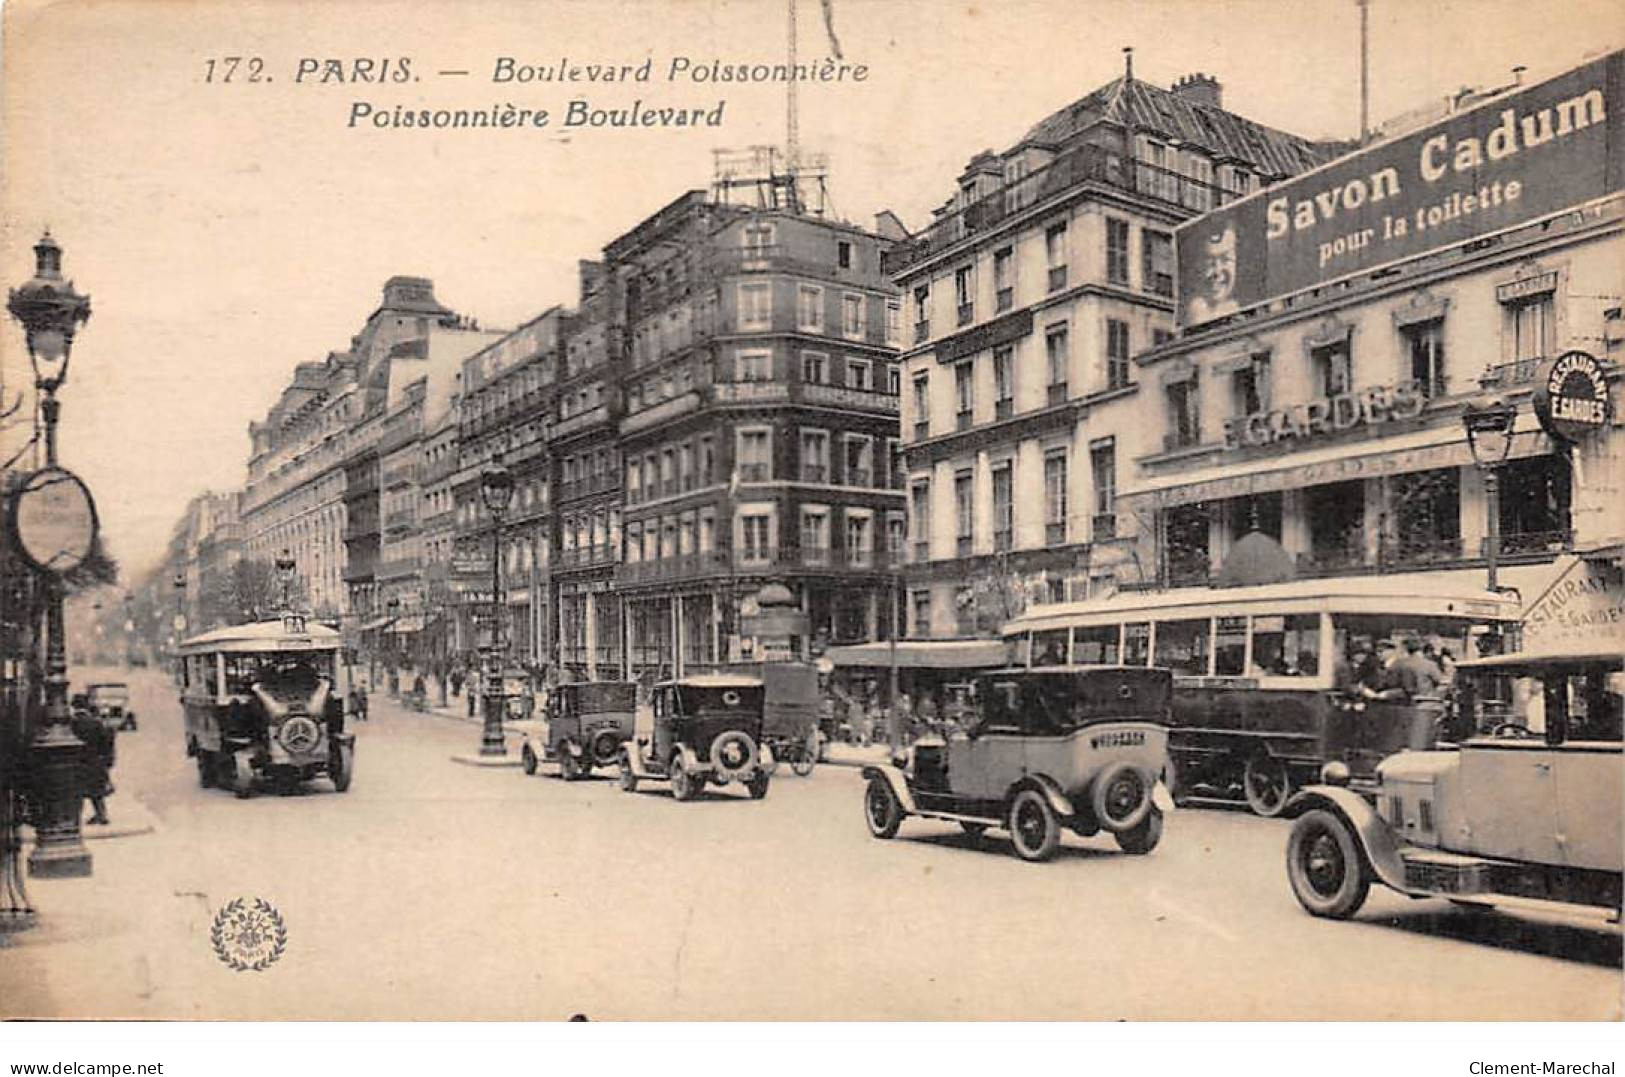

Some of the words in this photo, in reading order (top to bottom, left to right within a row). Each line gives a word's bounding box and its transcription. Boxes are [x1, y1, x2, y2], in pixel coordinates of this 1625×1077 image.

[1267, 166, 1401, 240] Savon
[1420, 89, 1606, 182] Cadum
[1319, 226, 1374, 267] pour
[1383, 216, 1408, 241] la
[1416, 180, 1522, 226] toilette
